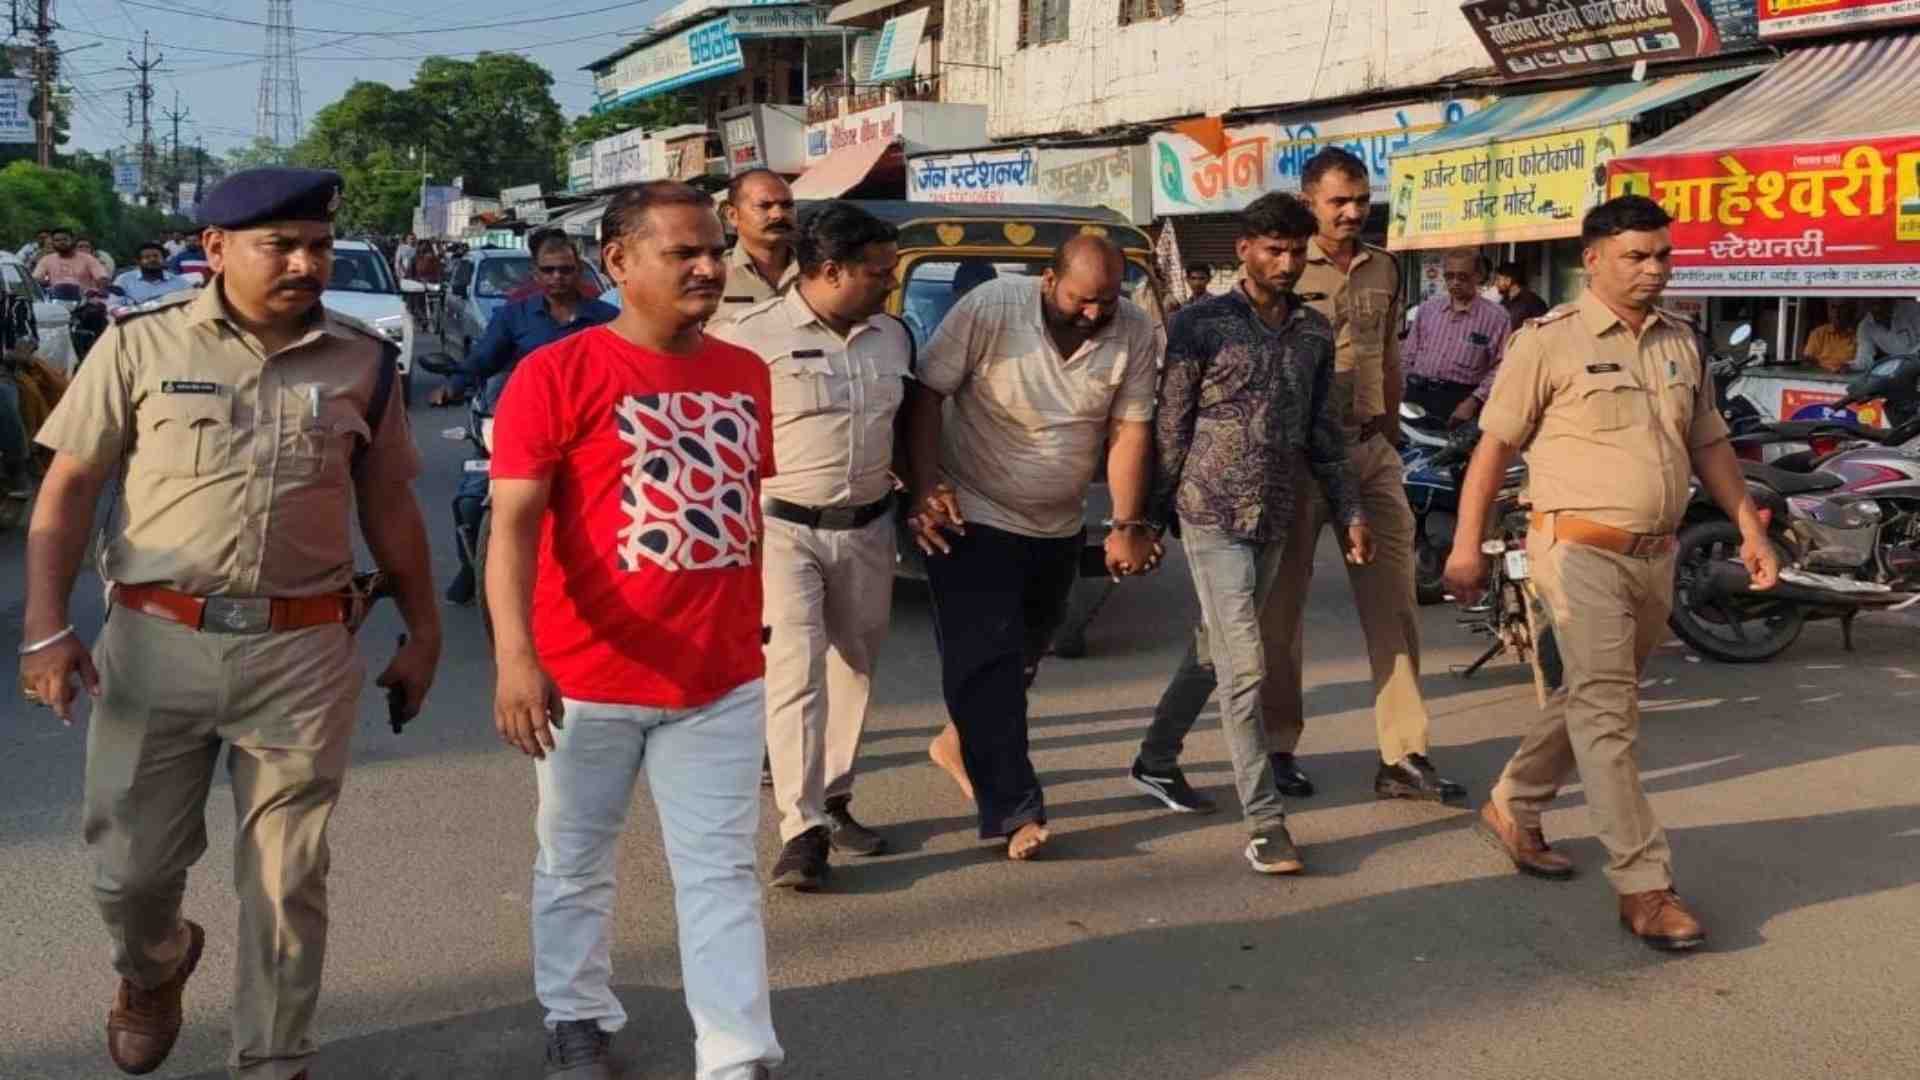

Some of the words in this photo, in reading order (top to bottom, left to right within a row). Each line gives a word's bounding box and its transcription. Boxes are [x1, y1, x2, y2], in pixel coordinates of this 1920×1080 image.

[951, 149, 1033, 190] स्टेशनरी
[1461, 153, 1490, 184] फोटो
[1519, 138, 1585, 176] फोटोकॉपी
[1656, 145, 1892, 226] माहेश्वरी
[1709, 229, 1824, 259] स्टेशनरी
